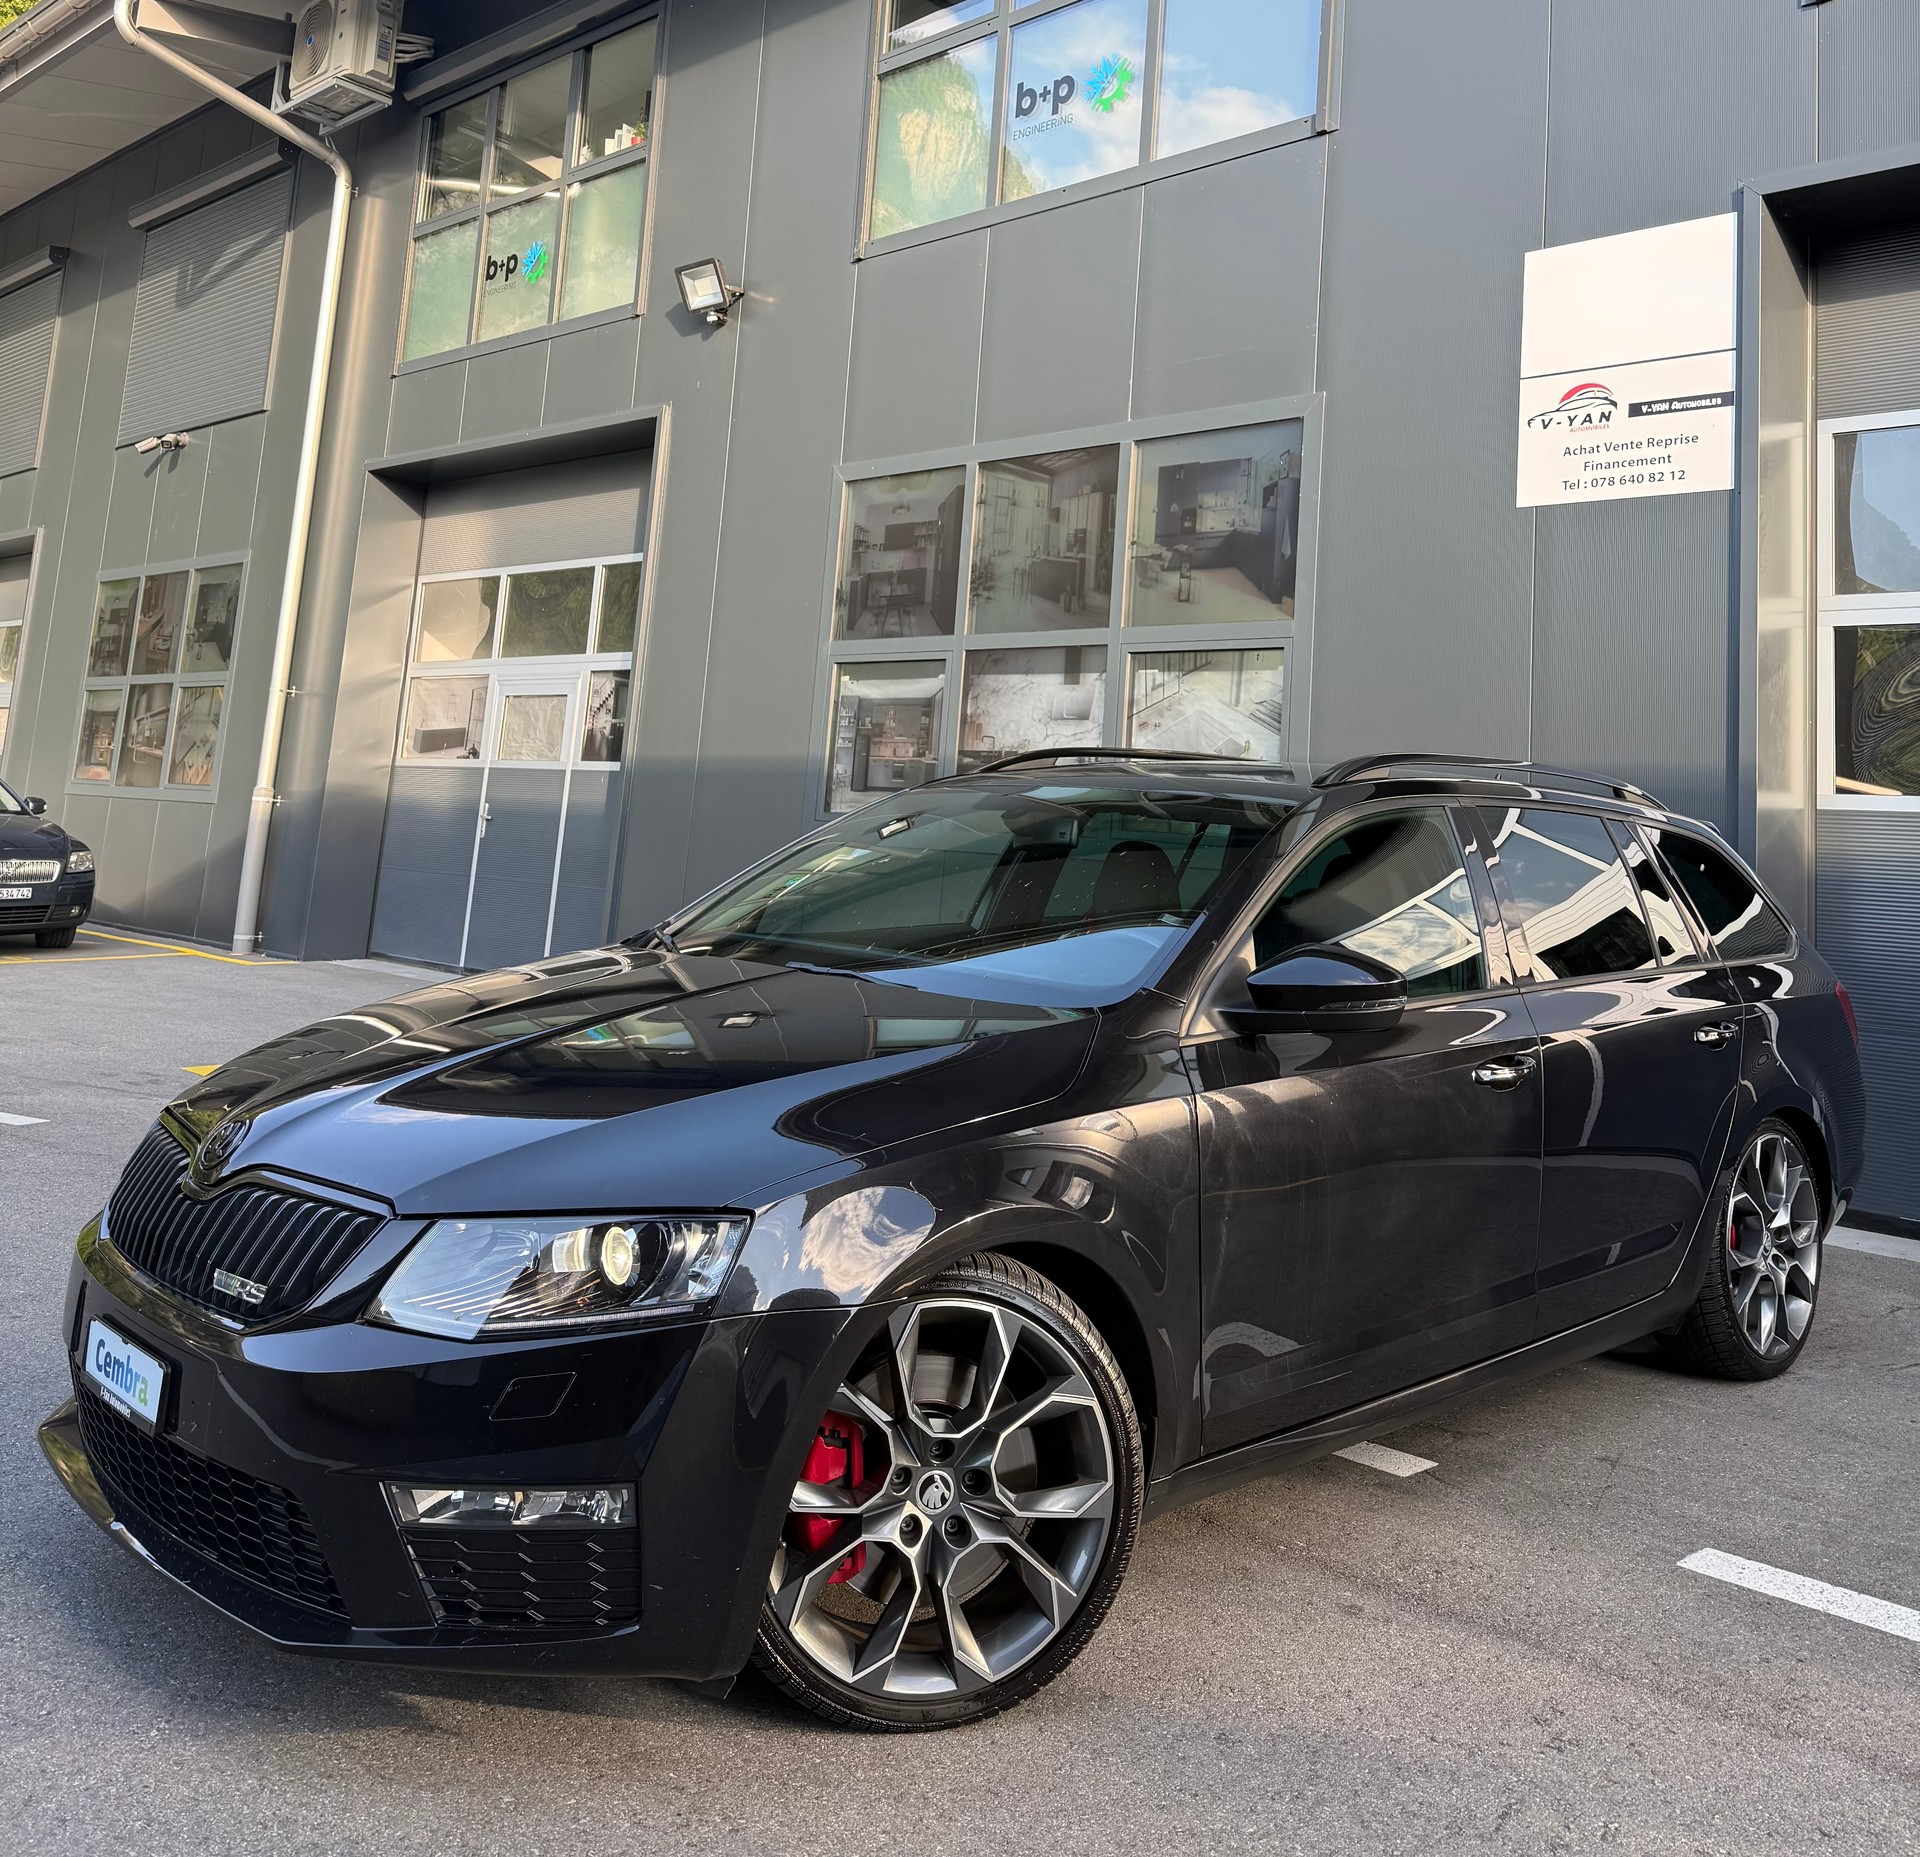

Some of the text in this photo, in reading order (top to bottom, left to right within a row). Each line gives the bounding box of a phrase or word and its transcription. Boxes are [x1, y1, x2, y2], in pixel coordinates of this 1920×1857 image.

[1015, 75, 1075, 119] b+p
[1013, 113, 1074, 141] ENGINEERING
[485, 254, 518, 282] b+p
[1569, 424, 1610, 433] AUTOMOBILES
[1563, 433, 1699, 457] Achat Vente Reprise
[1584, 454, 1672, 471] Financement
[1591, 476, 1615, 488] 078
[1619, 473, 1644, 485] 640
[1648, 471, 1665, 482] 82
[1670, 469, 1686, 481] 12
[96, 1338, 149, 1406] Cembra
